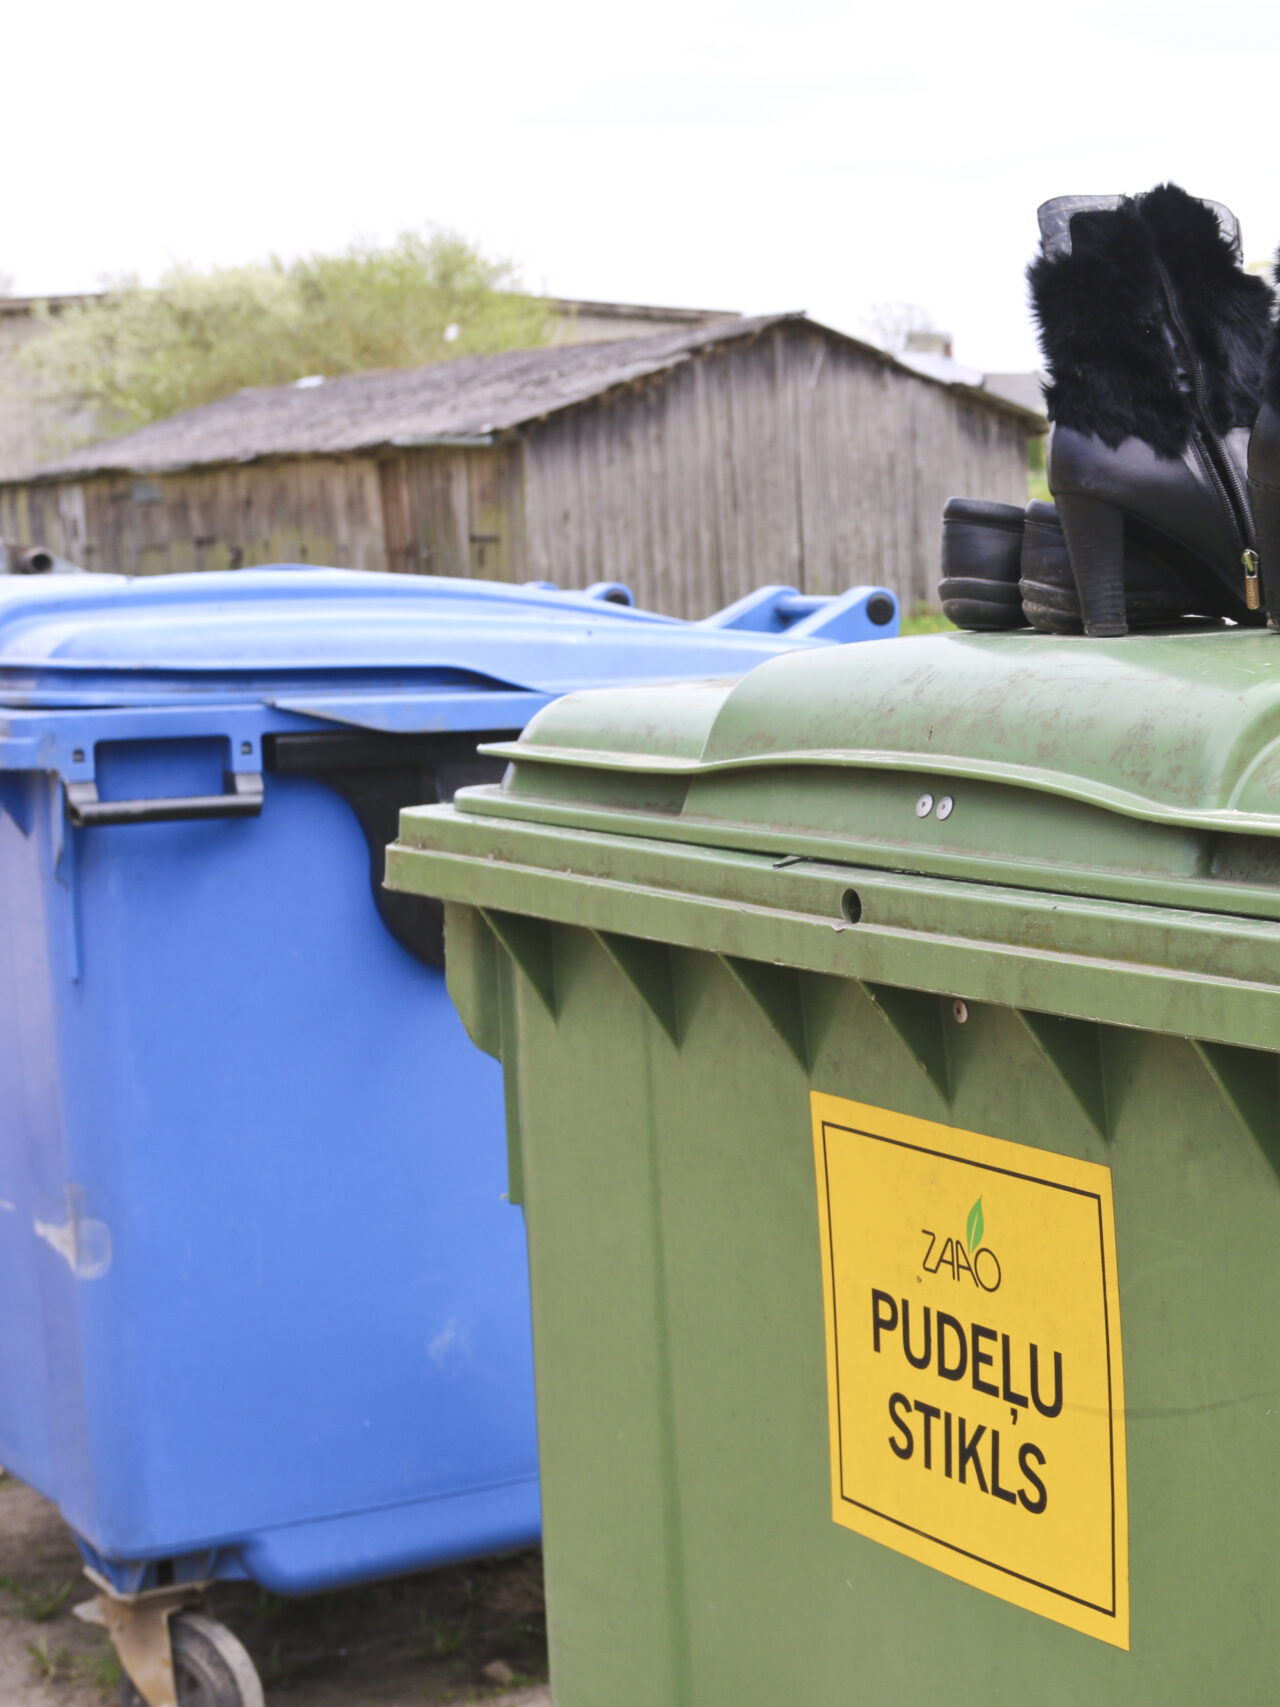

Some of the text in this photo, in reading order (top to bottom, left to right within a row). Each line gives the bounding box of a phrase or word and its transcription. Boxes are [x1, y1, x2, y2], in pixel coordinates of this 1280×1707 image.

[921, 1228, 1002, 1293] ZAAO
[871, 1288, 1063, 1425] PUDEĻU
[888, 1392, 1048, 1515] STIKLS
